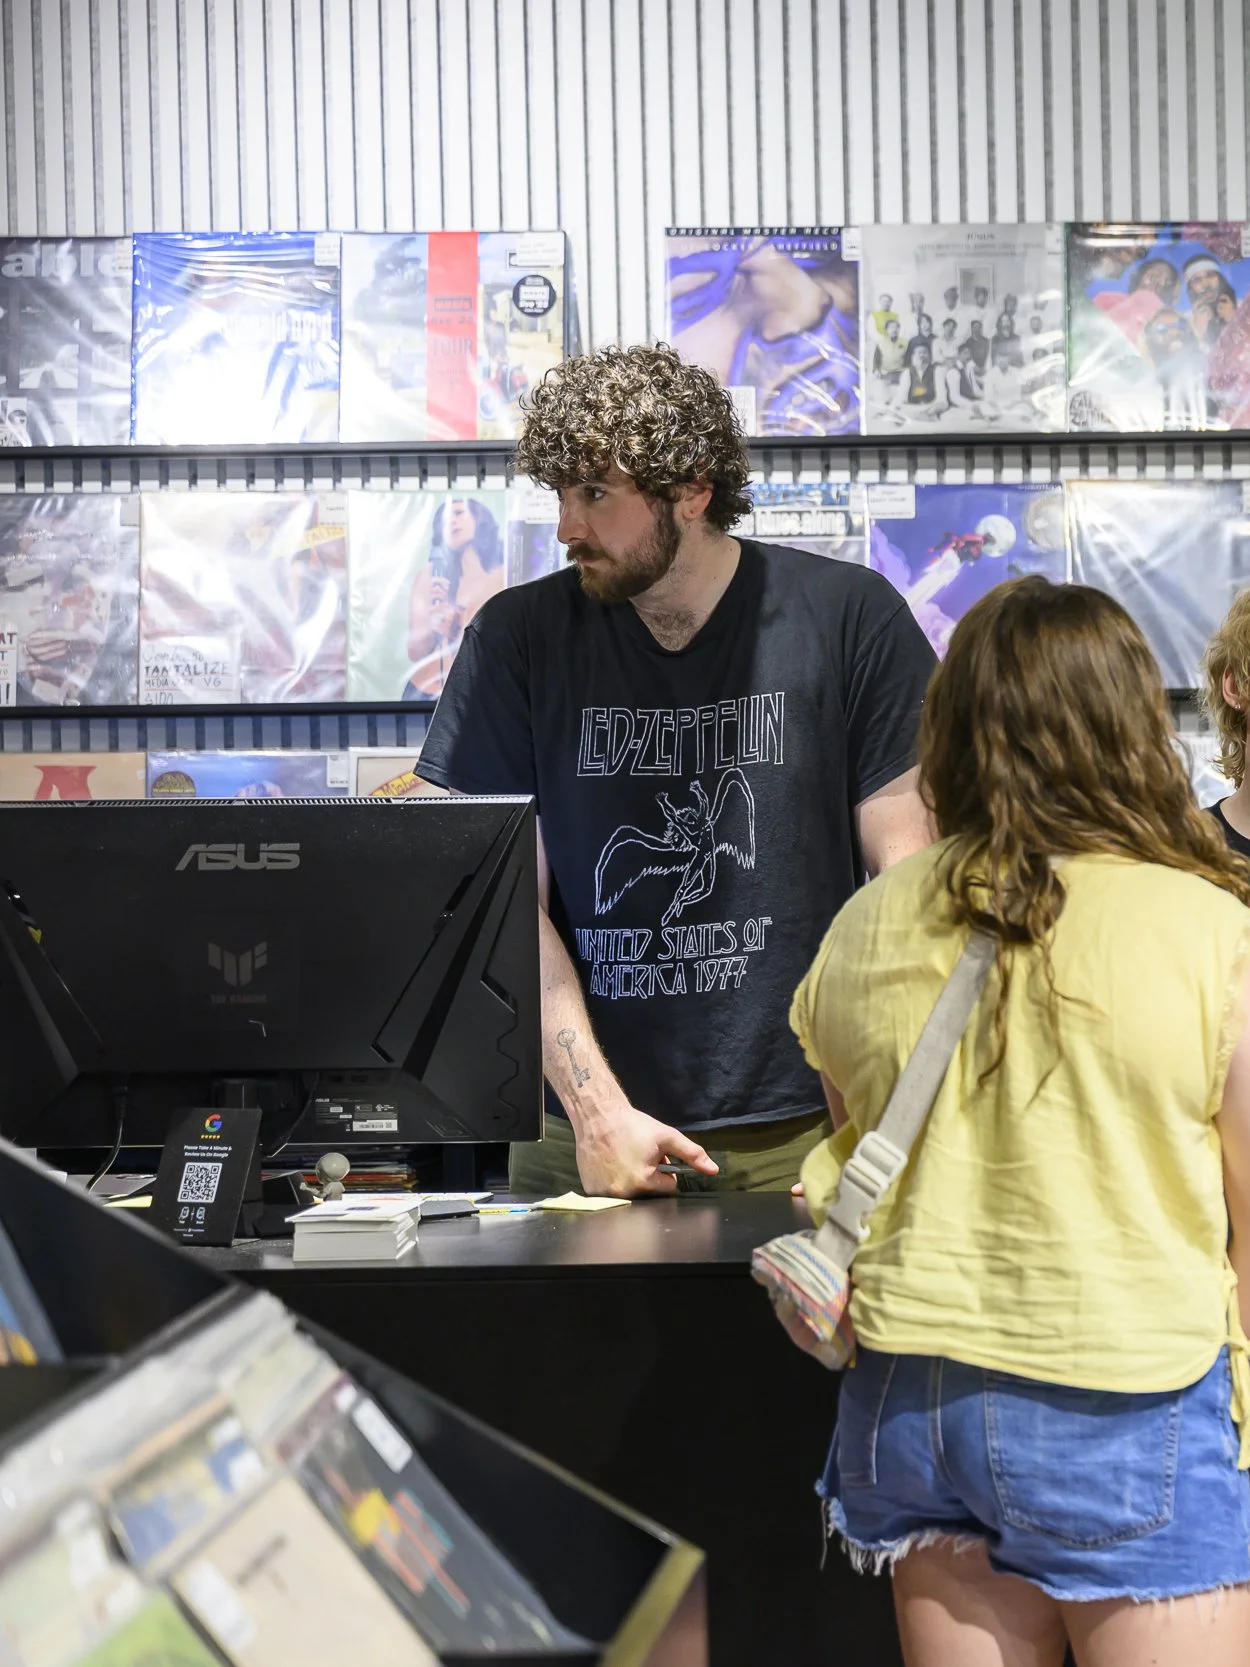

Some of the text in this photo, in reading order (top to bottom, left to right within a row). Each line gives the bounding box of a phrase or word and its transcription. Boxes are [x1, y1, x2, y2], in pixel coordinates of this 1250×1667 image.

[742, 227, 797, 236] MASTER
[175, 842, 301, 871] ASUS
[575, 915, 774, 964] UNITED STATES OF
[590, 955, 749, 1000] AMERICA 1977
